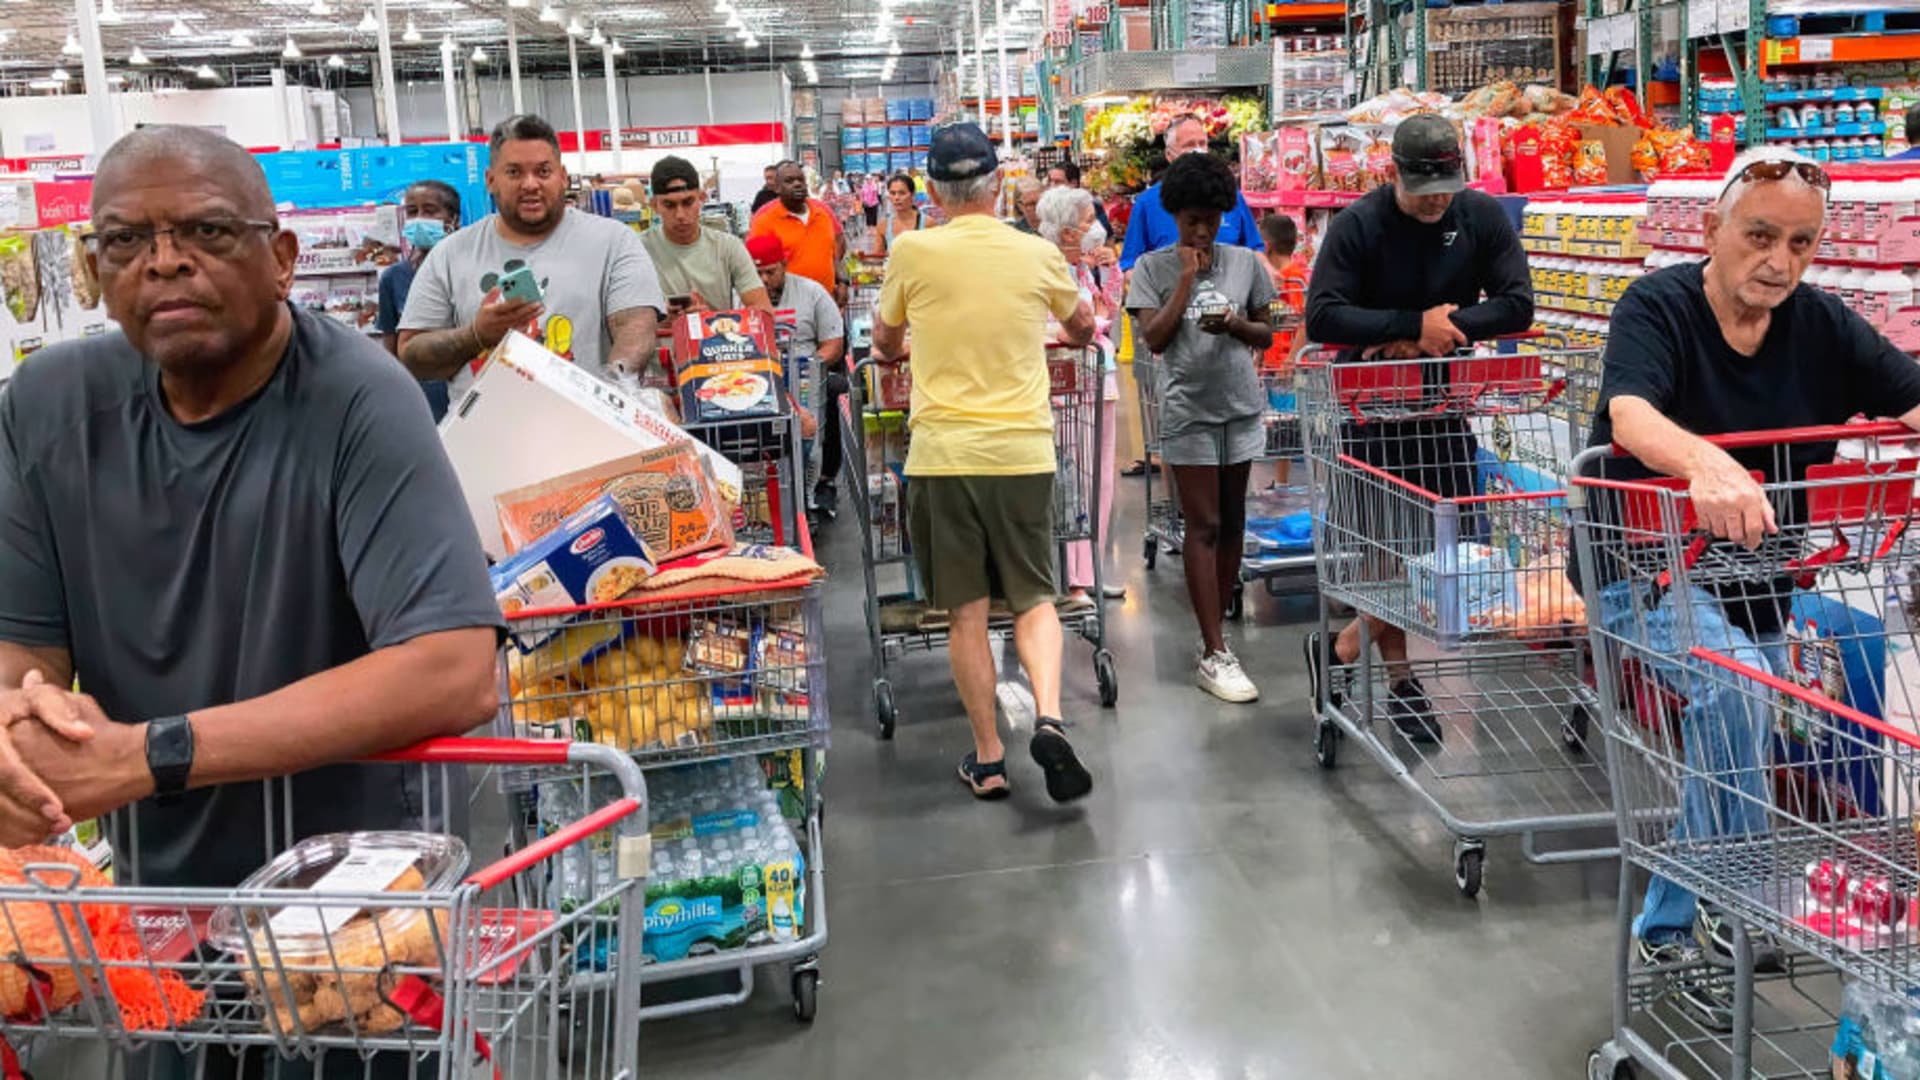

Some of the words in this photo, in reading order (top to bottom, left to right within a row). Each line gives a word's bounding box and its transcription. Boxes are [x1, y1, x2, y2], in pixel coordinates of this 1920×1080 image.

[656, 131, 690, 145] DELI
[702, 344, 754, 357] QUAKER
[643, 902, 717, 930] phyrhills
